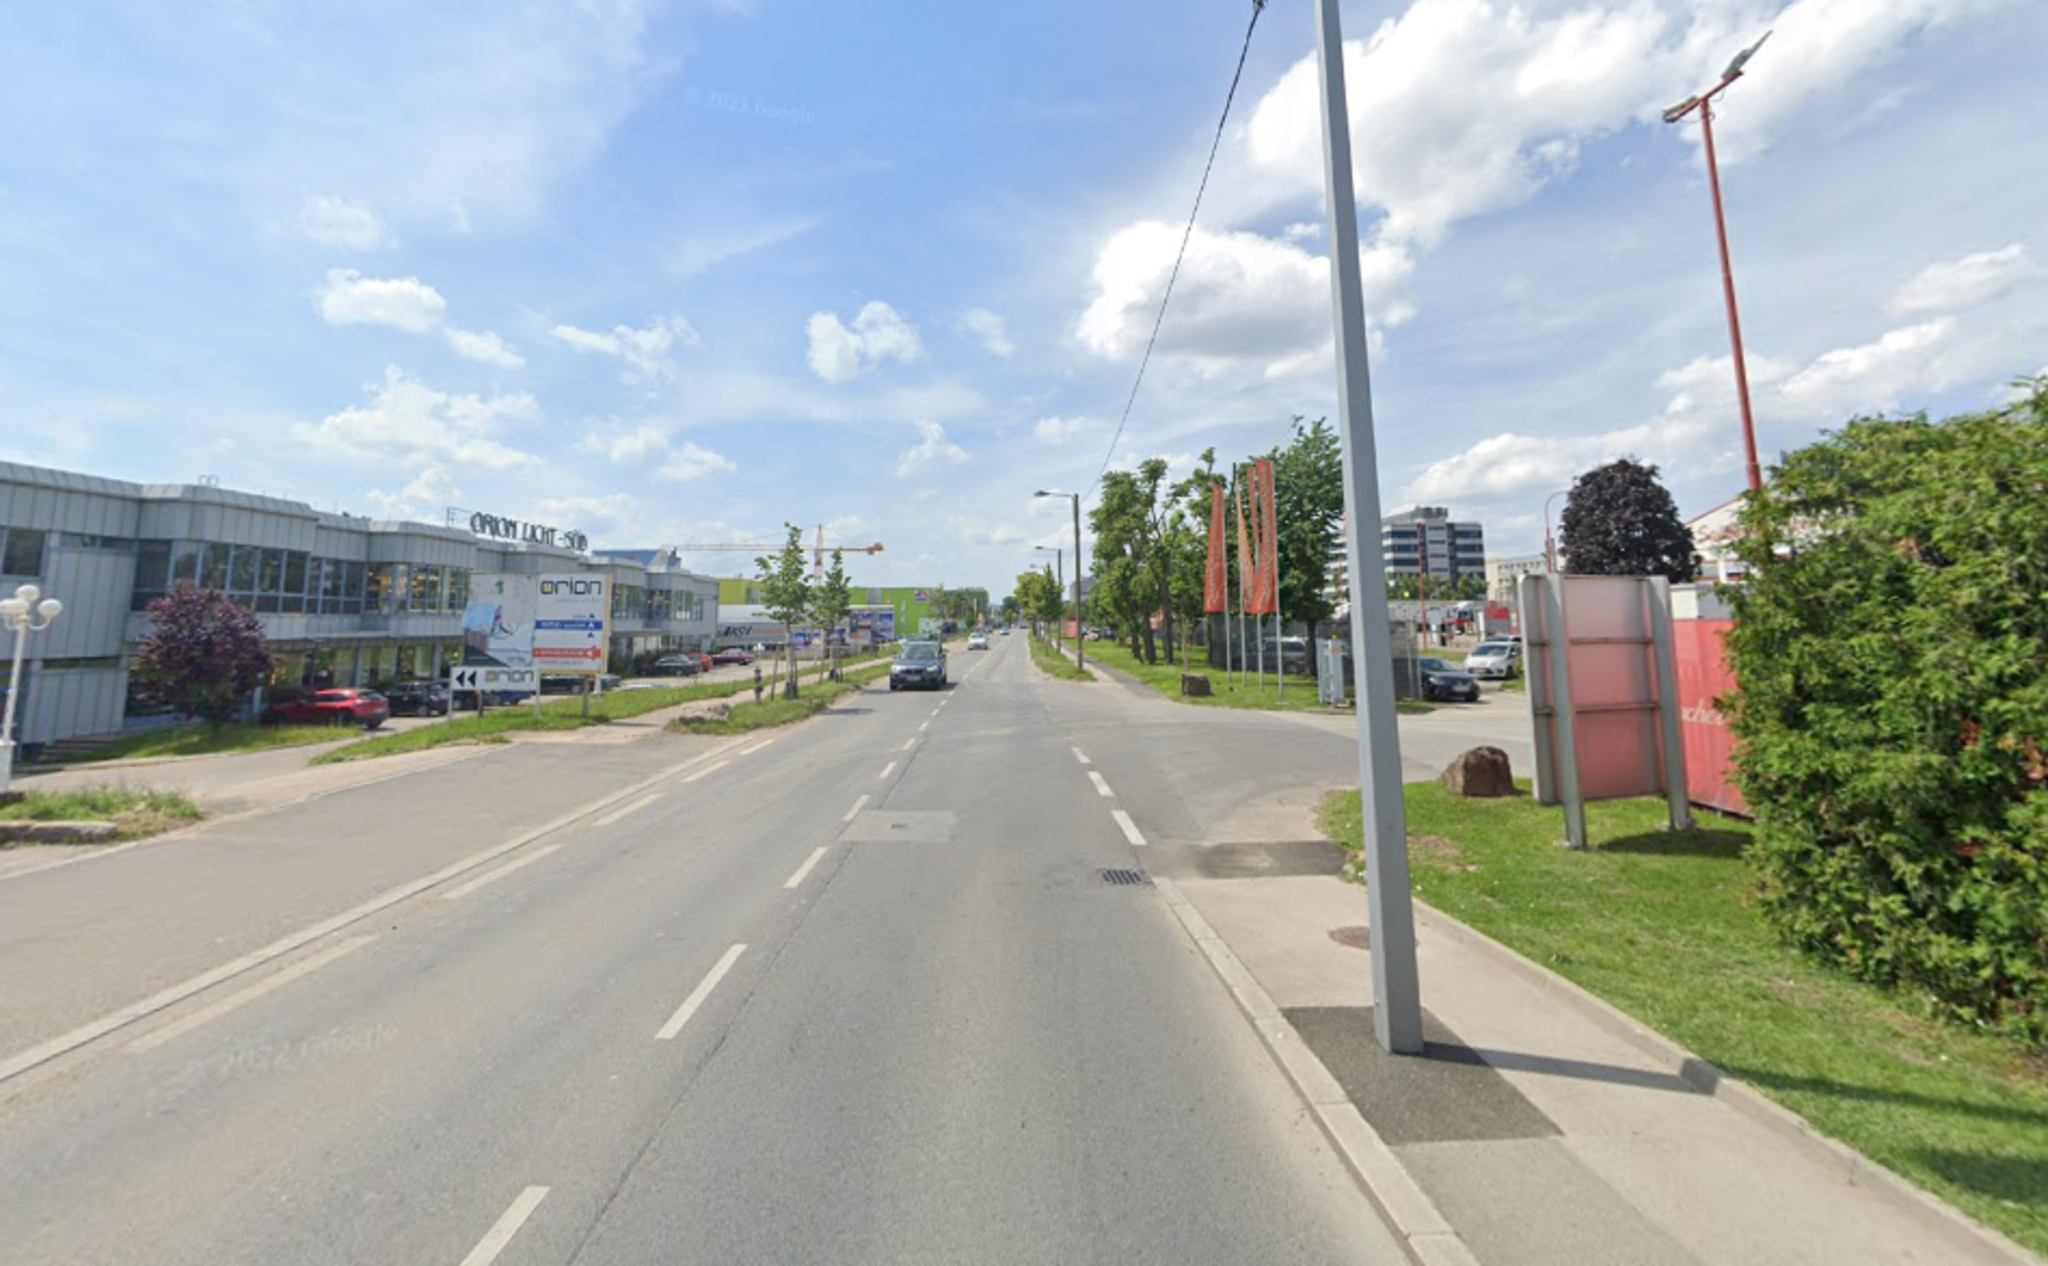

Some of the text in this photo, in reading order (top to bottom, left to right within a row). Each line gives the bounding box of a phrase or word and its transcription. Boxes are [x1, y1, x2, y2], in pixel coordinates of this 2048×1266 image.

[470, 511, 517, 540] ORION
[540, 577, 602, 595] orion
[484, 669, 535, 683] orion
